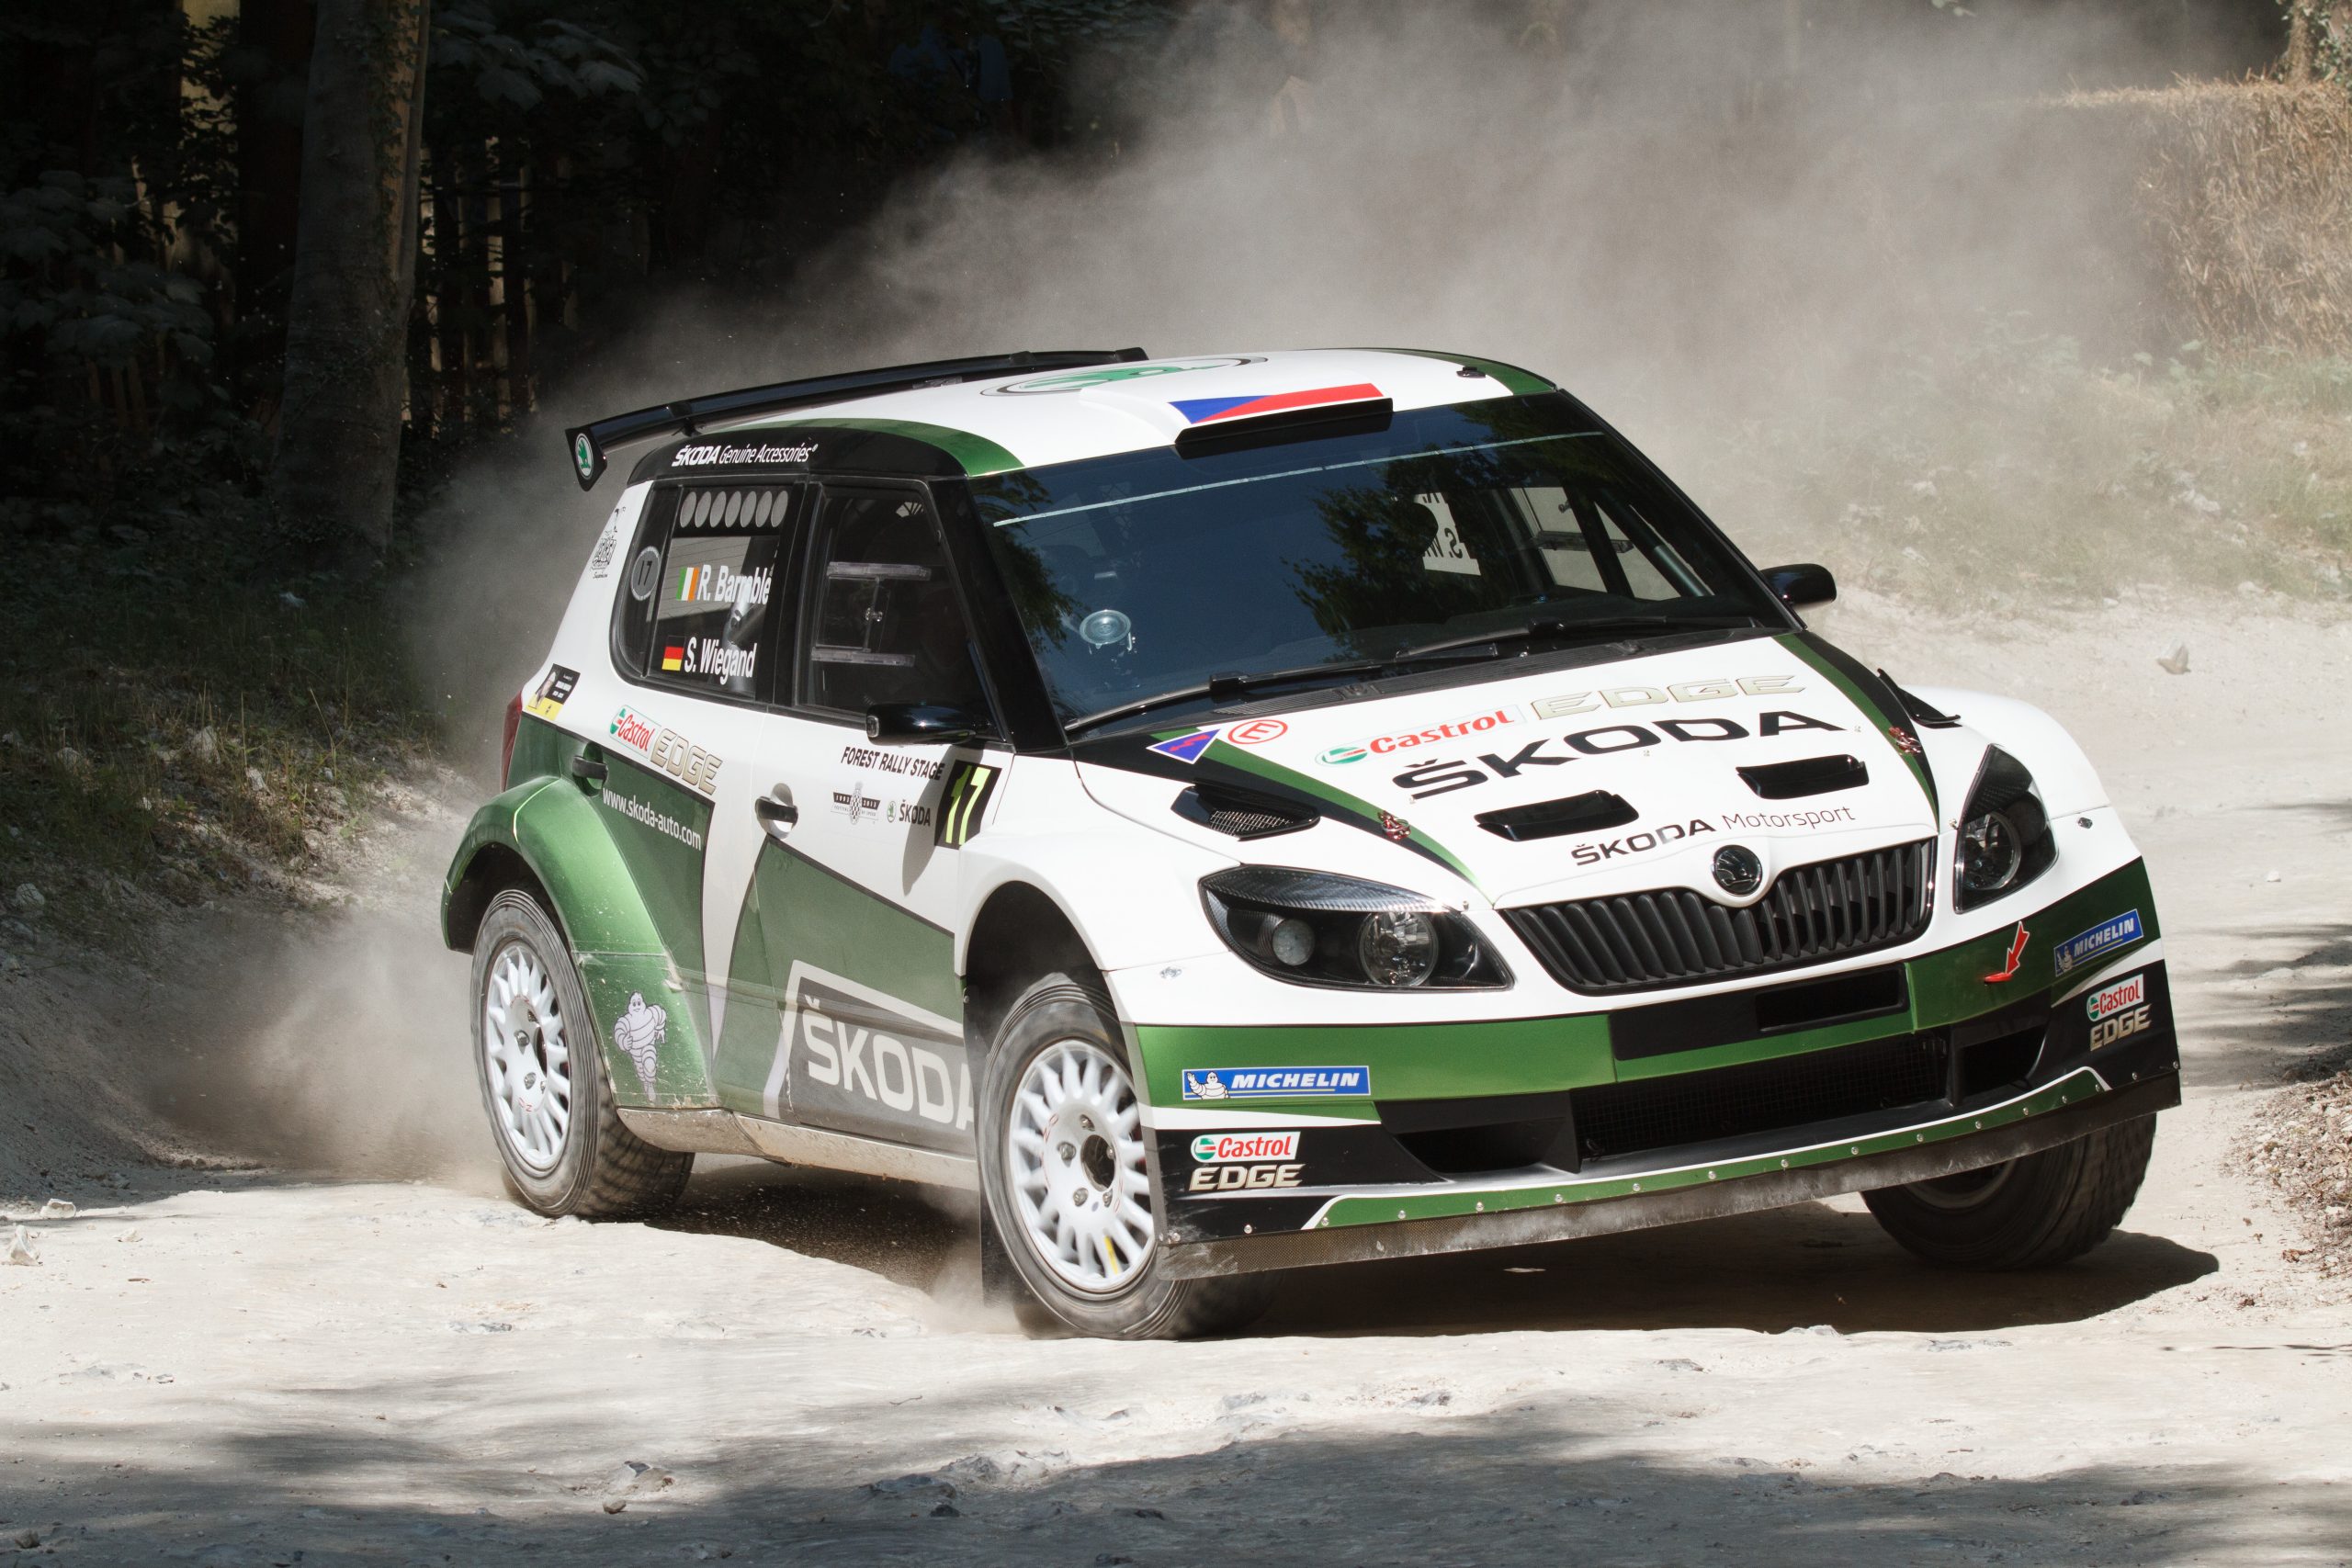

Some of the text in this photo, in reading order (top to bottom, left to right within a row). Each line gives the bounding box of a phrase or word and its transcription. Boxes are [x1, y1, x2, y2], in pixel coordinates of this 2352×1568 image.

[672, 445, 721, 467] ŠKODA
[719, 444, 756, 464] Genuine
[638, 560, 653, 586] 17
[696, 564, 712, 601] R.
[684, 637, 757, 685] S. Wiegand
[1370, 675, 1805, 754] Castrol EDGE
[617, 714, 723, 795] Castrol EDGE
[841, 746, 945, 781] FOREST RALLY STAGE
[1393, 710, 1847, 800] ŠKODA
[603, 787, 702, 851] www.skoda-auto.com
[899, 799, 931, 827] ŠKODA
[945, 764, 991, 846] 17
[1570, 805, 1856, 866] ŠKODA Motorsport
[2074, 917, 2135, 957] MICHELIN
[2099, 979, 2140, 1014] Castrol
[2090, 1003, 2153, 1051] EDGE
[1231, 1072, 1360, 1089] MICHELIN
[1217, 1135, 1292, 1158] Castrol
[1188, 1163, 1306, 1191] EDGE
